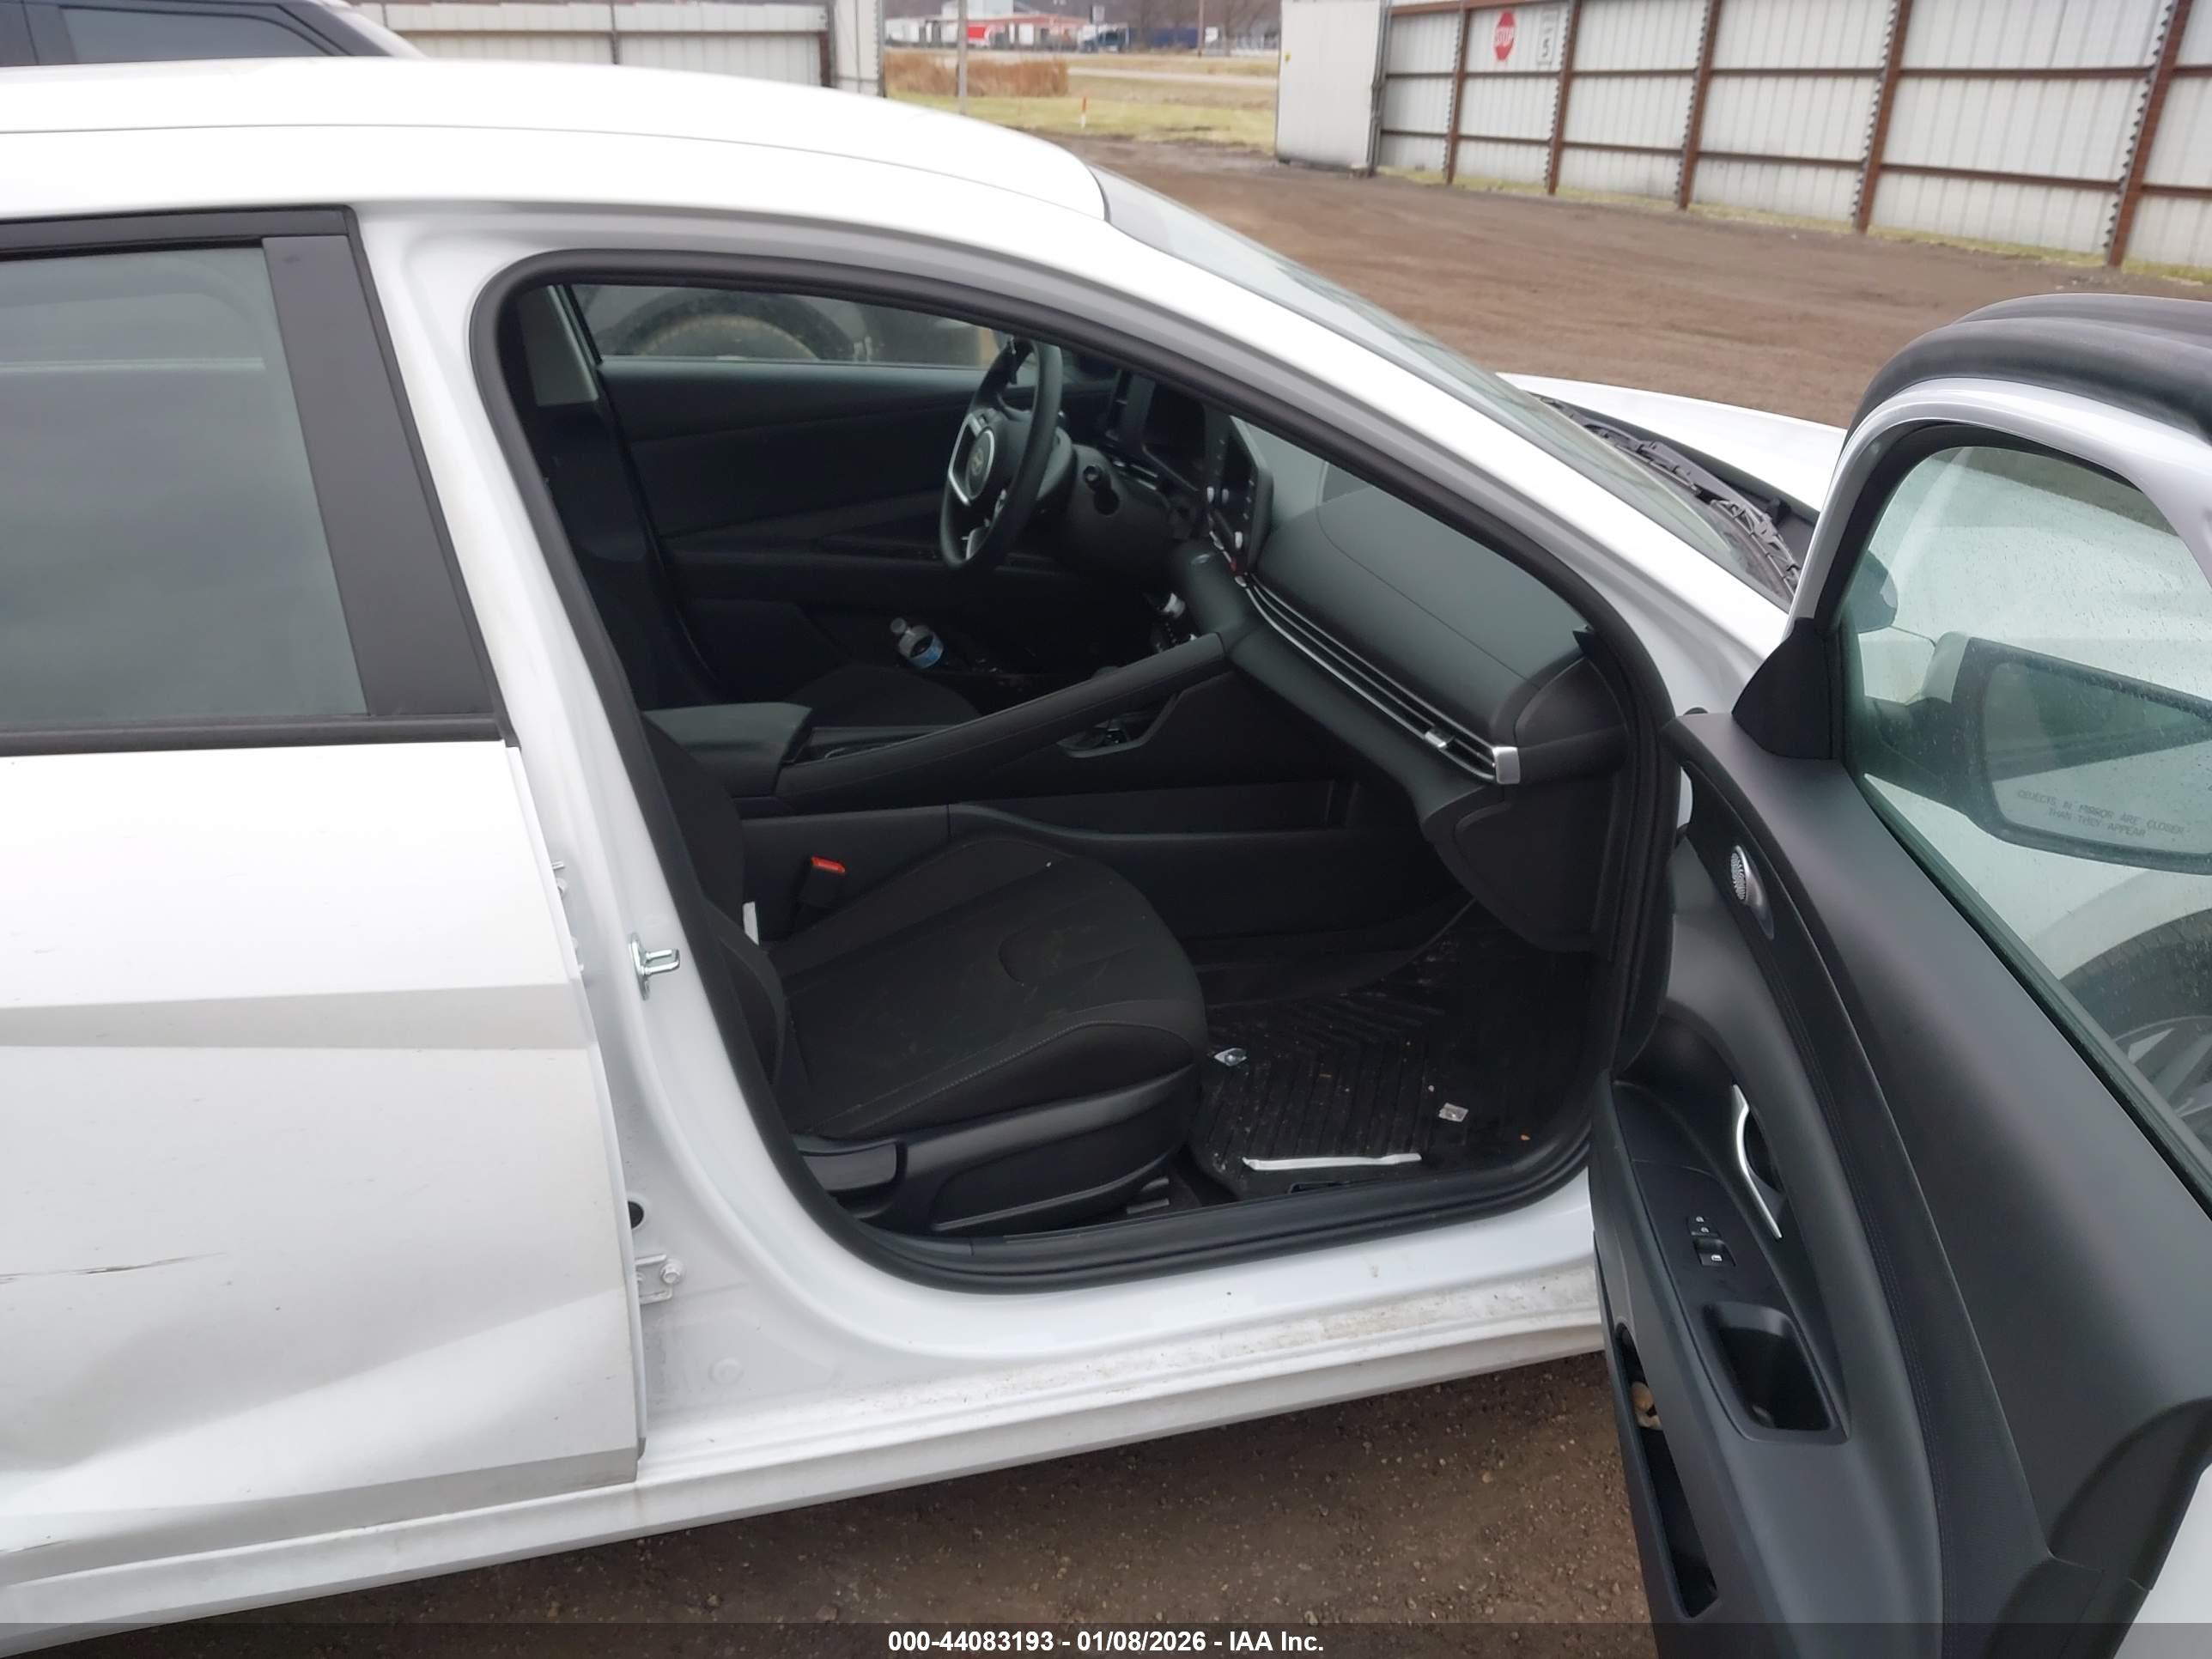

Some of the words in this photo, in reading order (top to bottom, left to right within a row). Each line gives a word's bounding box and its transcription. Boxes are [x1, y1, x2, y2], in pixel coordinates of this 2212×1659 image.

[2017, 789, 2057, 805] OBJECTS
[2063, 800, 2073, 810] IN
[2079, 804, 2114, 819] MIRROR
[2119, 811, 2138, 824] ARE
[2147, 818, 2185, 835] CLOSER
[2048, 807, 2071, 821] THAN
[2077, 815, 2101, 828] THEY
[2107, 823, 2146, 837] APPEAR
